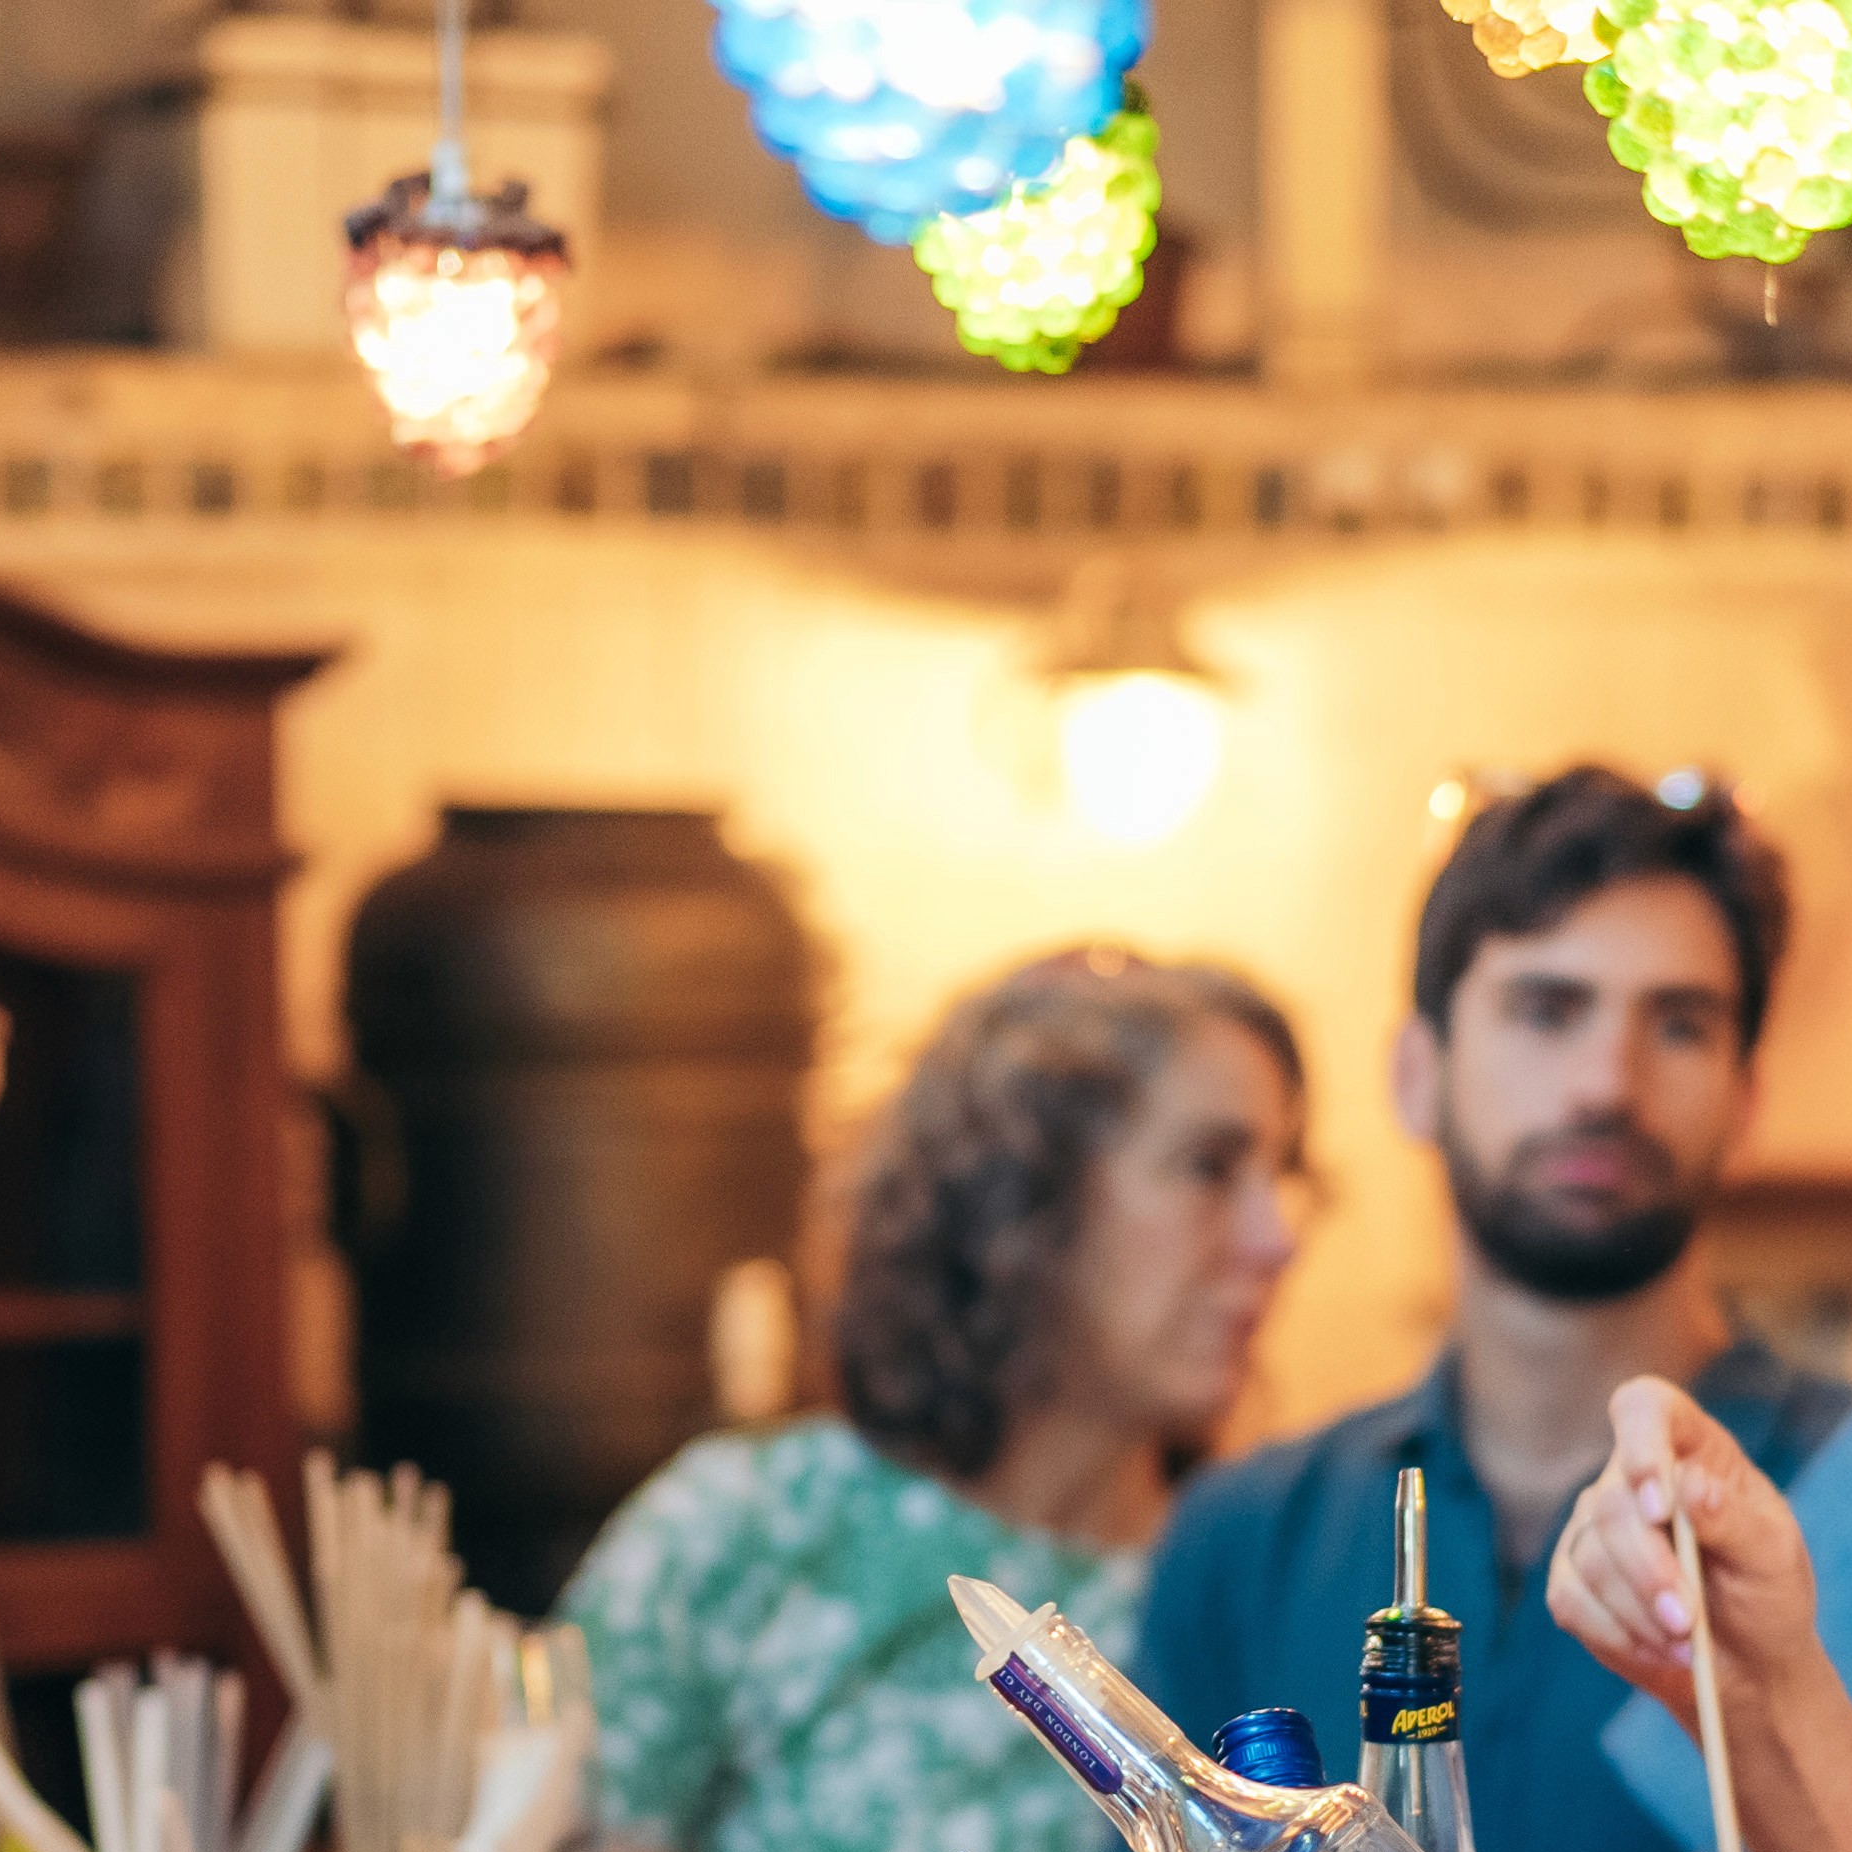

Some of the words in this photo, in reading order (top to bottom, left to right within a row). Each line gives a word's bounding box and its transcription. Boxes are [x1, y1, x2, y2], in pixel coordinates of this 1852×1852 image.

[999, 1670, 1015, 1686] GI
[1017, 1689, 1043, 1712] DRY
[1391, 1700, 1454, 1735] APEROL
[1045, 1714, 1097, 1769] LONDON
